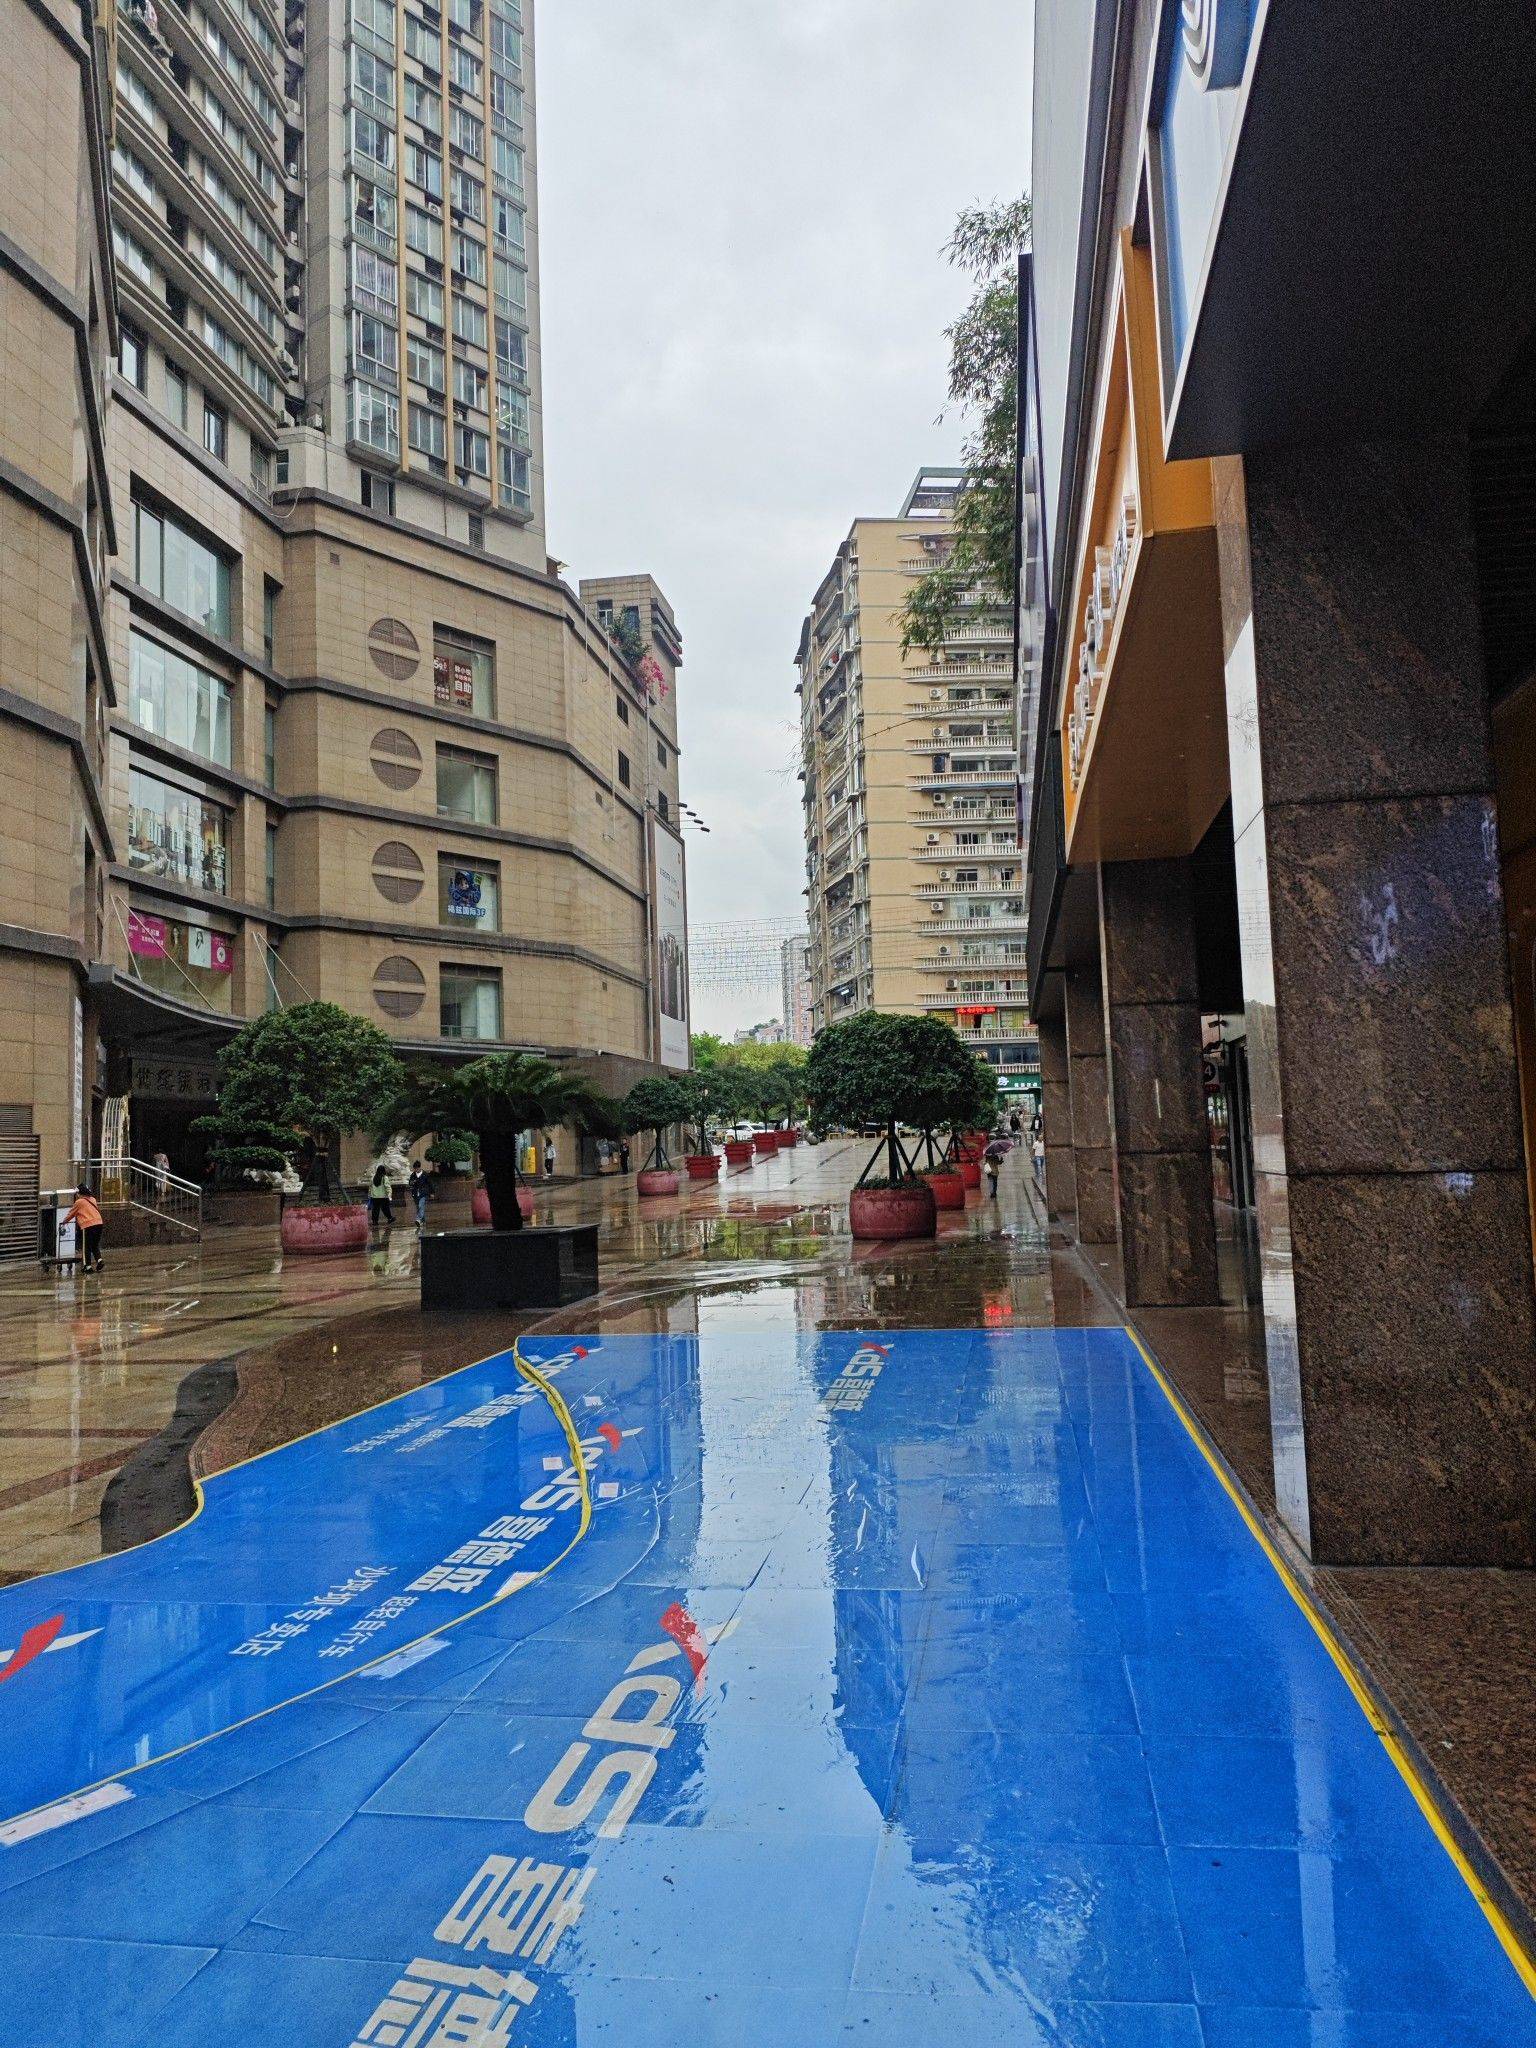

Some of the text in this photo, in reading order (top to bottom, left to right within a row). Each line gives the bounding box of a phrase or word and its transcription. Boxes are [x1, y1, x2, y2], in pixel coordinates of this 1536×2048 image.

[404, 1515, 554, 1594] 喜德盛
[229, 1565, 397, 1657] 沙坪坝专卖店
[318, 1595, 419, 1658] 超轻自行车
